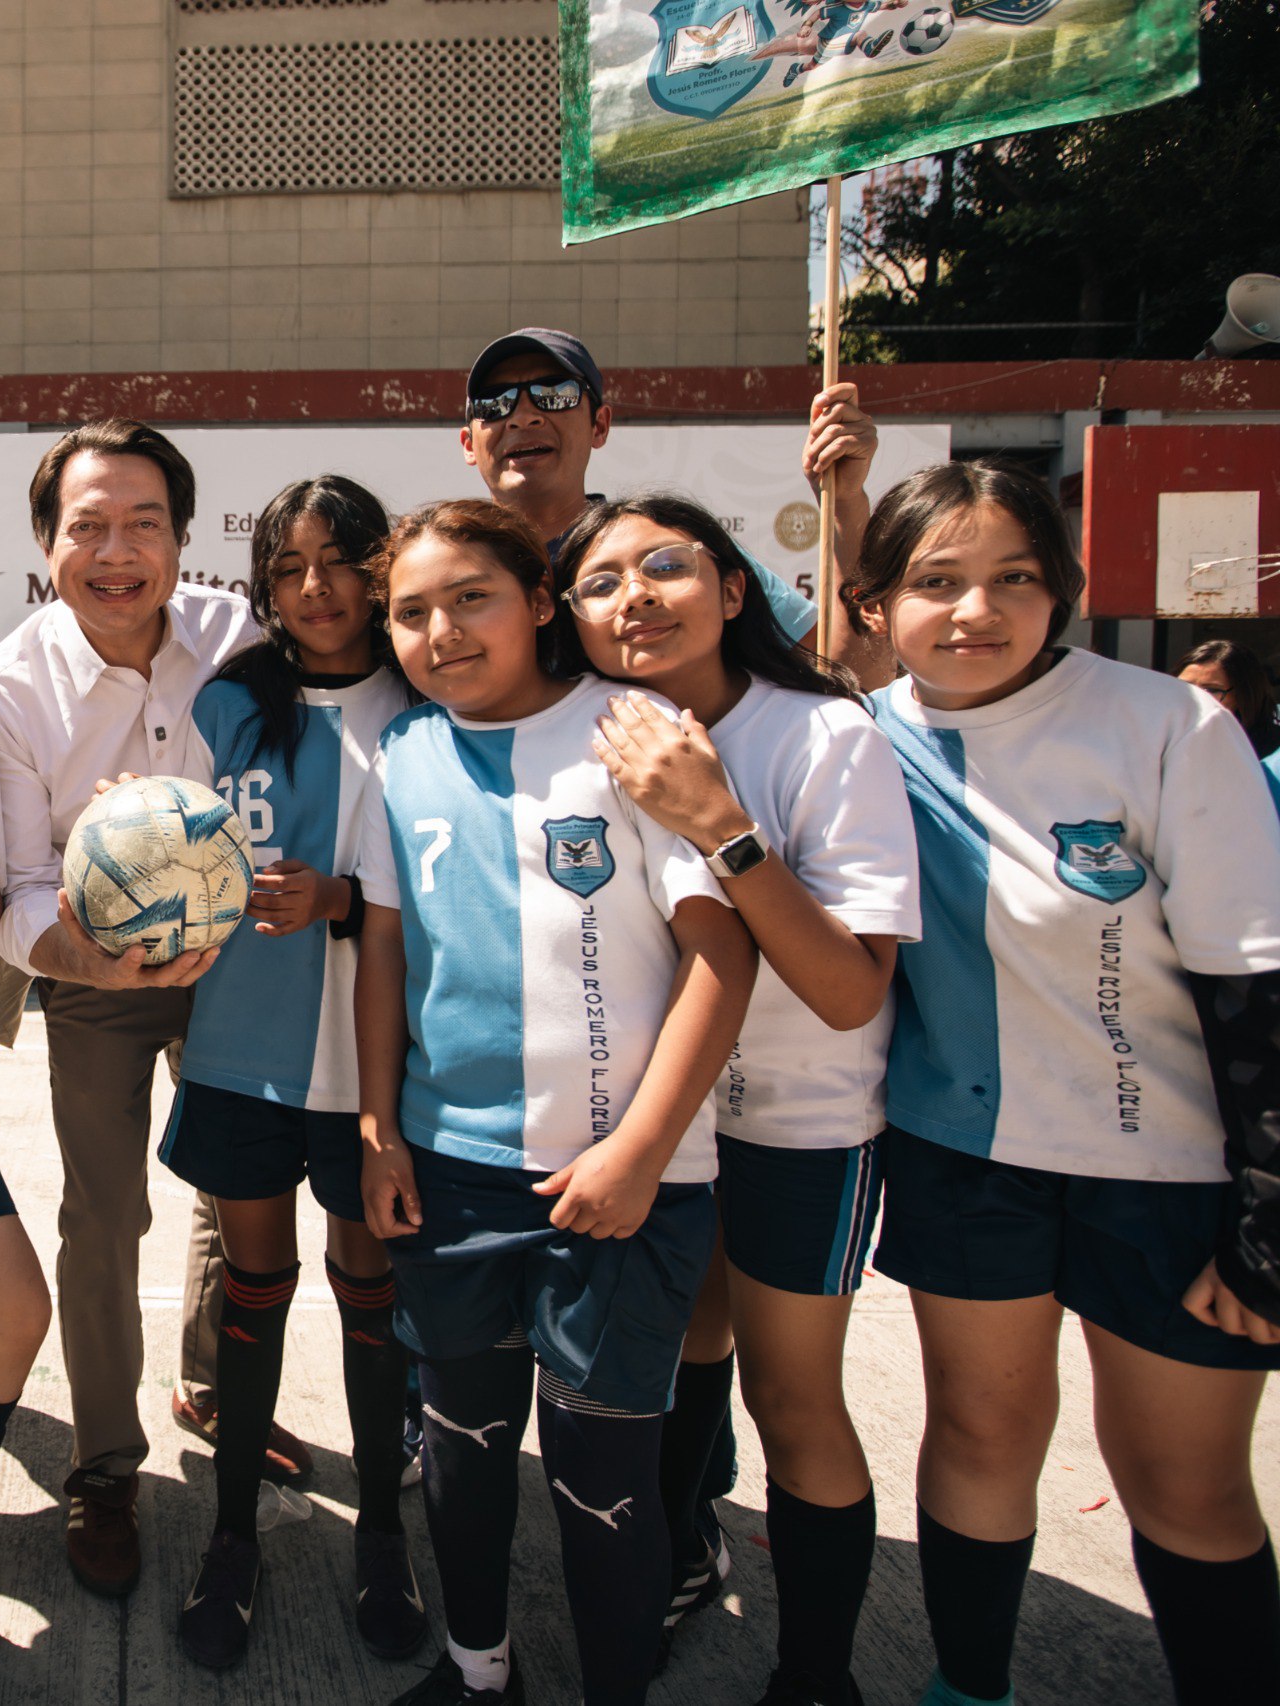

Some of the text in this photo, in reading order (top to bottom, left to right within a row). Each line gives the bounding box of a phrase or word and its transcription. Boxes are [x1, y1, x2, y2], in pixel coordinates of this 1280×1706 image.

[668, 65, 757, 96] Jesús Romero Flores
[699, 68, 723, 80] Profr.
[224, 512, 260, 533] Ed
[414, 816, 452, 893] 7
[216, 876, 230, 898] FIFA
[581, 905, 599, 972] JESUS
[582, 978, 610, 1062] ROMERO
[1097, 915, 1142, 1134] JESUS ROMERO FLORES
[726, 1062, 746, 1118] LORES
